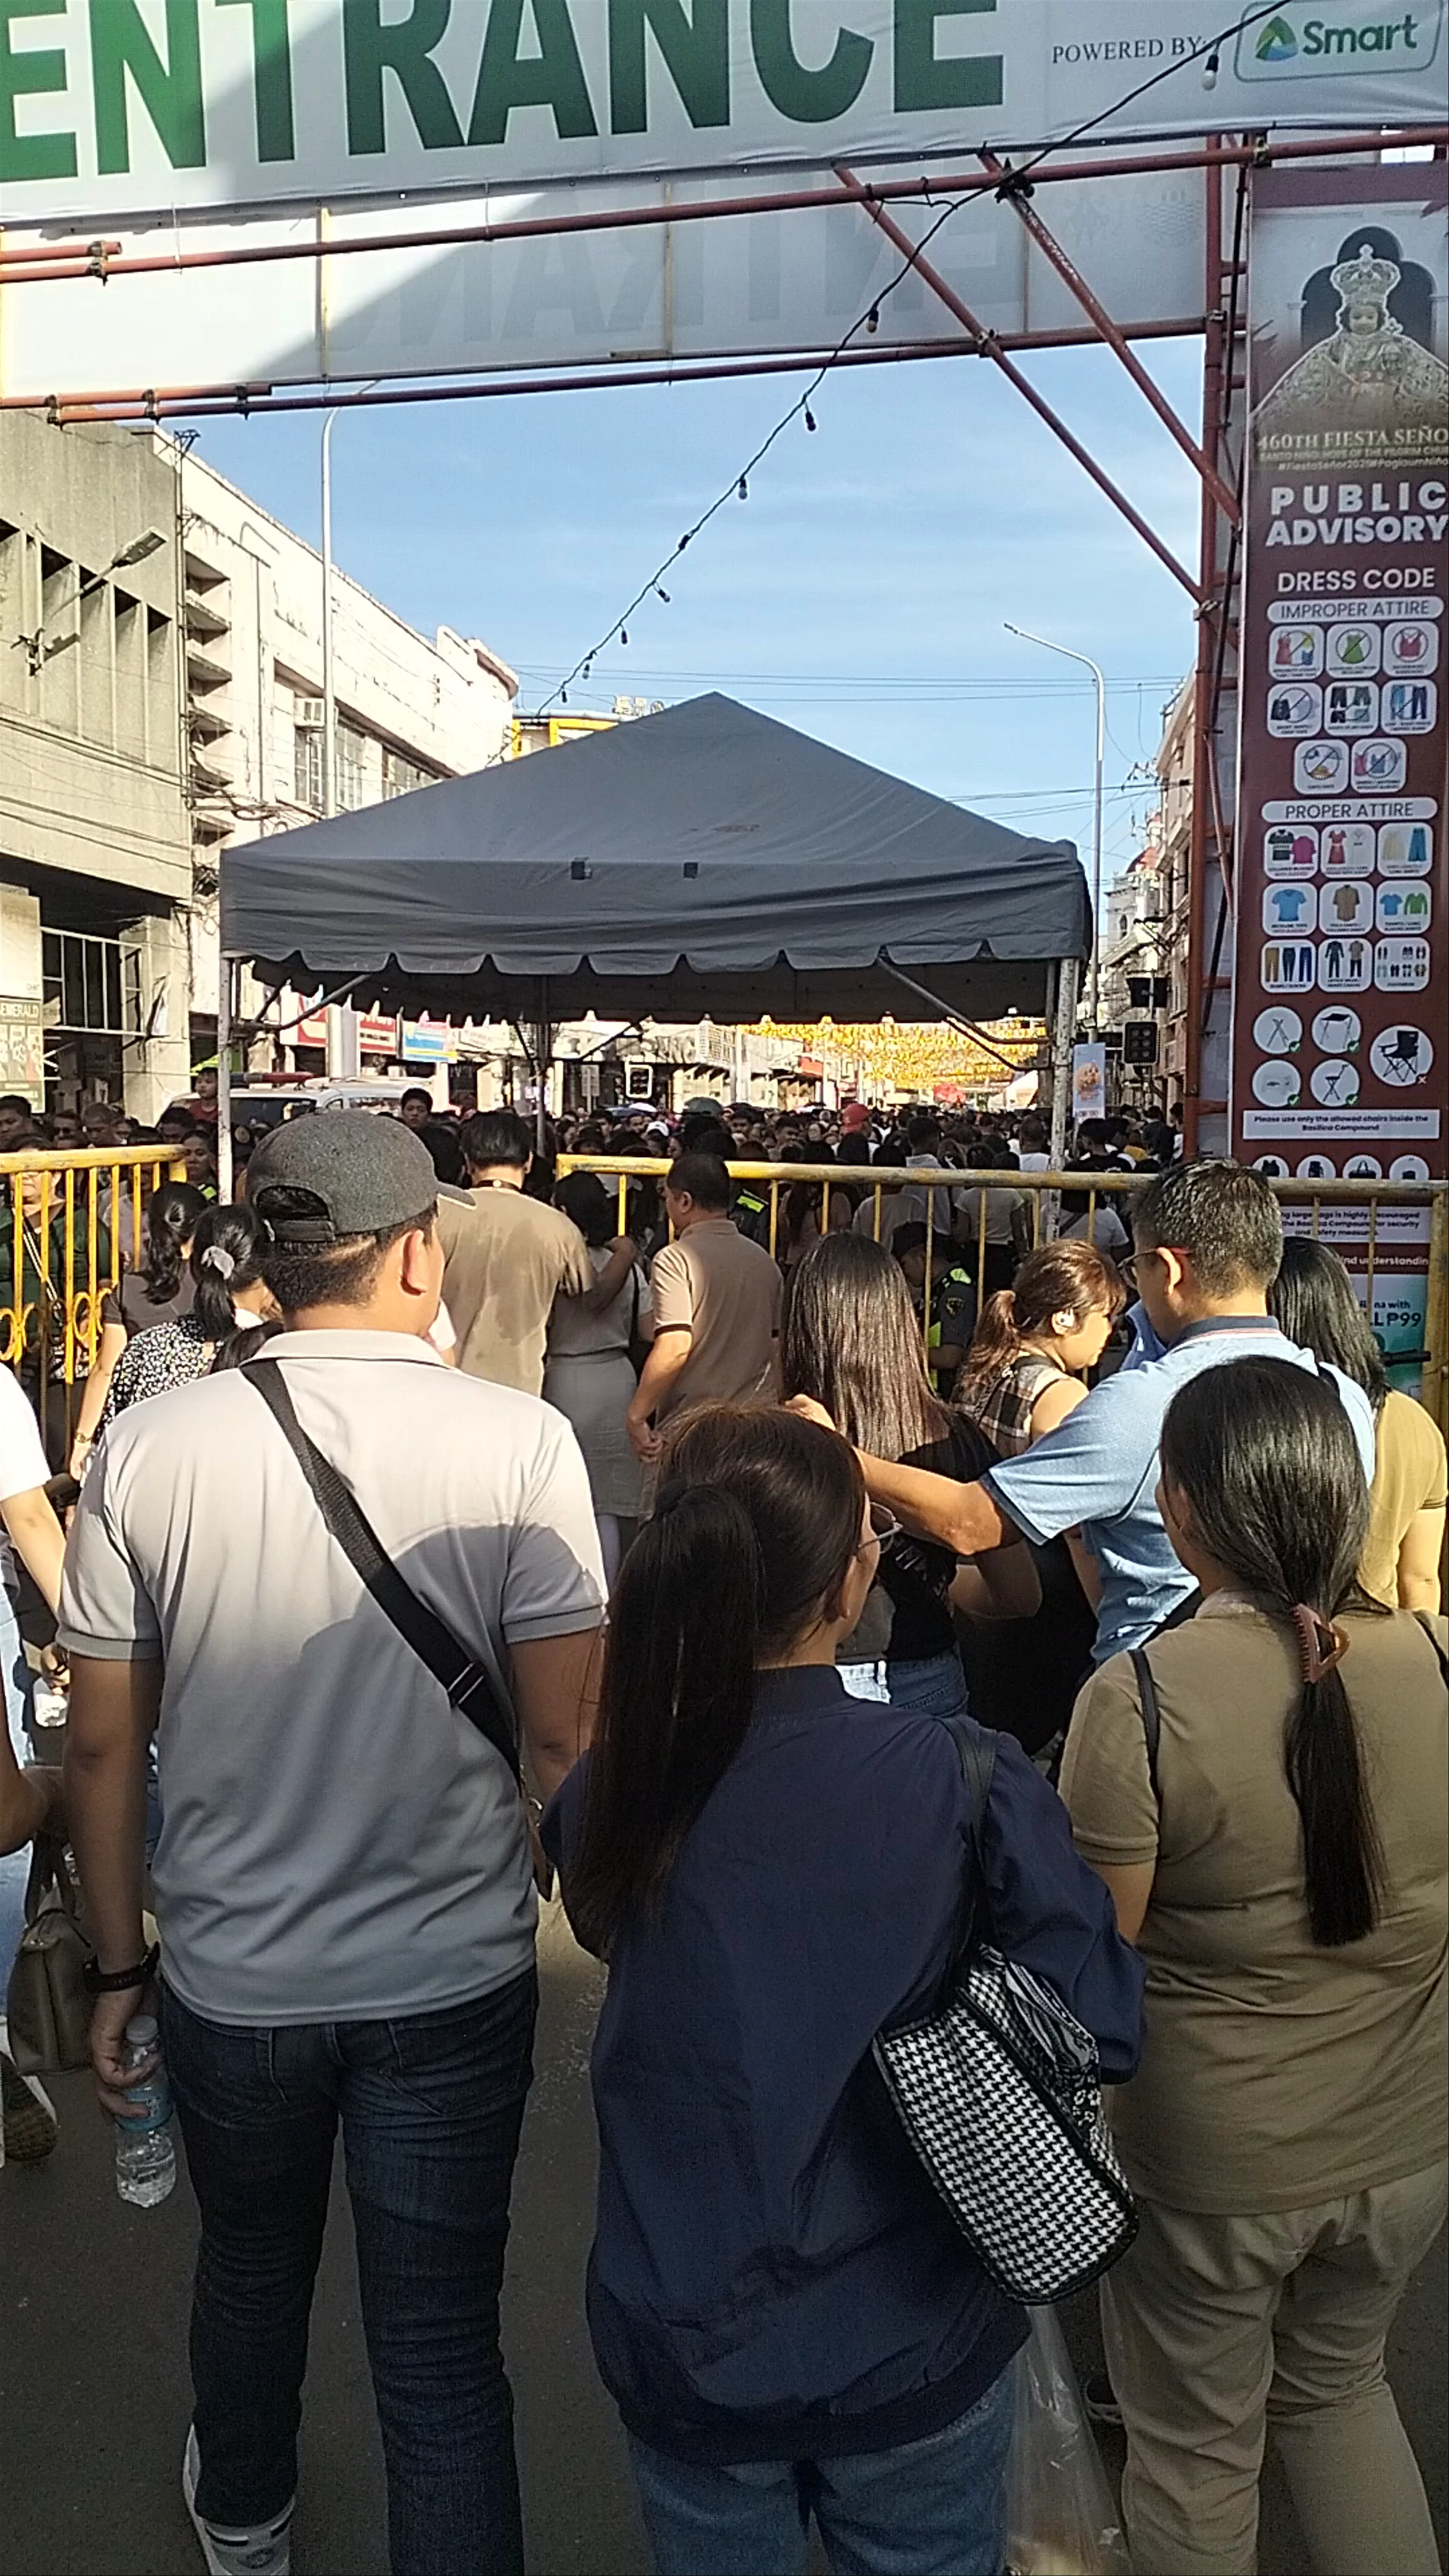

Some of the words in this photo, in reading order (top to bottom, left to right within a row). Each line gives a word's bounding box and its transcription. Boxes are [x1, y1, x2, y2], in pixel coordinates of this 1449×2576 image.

[1303, 14, 1418, 55] Smart
[1052, 39, 1164, 63] POWERED
[0, 0, 1003, 182] ENTRANCE
[1258, 434, 1318, 450] 460TH
[1324, 430, 1389, 447] FIESTA
[1271, 481, 1446, 515] PUBLIC
[1266, 515, 1448, 546] ADVISORY
[1278, 571, 1357, 592] DRESS
[1363, 567, 1435, 589] CODE
[1281, 603, 1367, 619] IMPROPER
[1373, 600, 1430, 615] ATTIRE
[1285, 804, 1351, 818] PROPER
[1357, 802, 1414, 817] ATTIRE
[1343, 1210, 1368, 1220] highly
[1387, 1220, 1419, 1229] security
[1387, 1300, 1410, 1309] with
[1371, 1312, 1421, 1327] LP99
